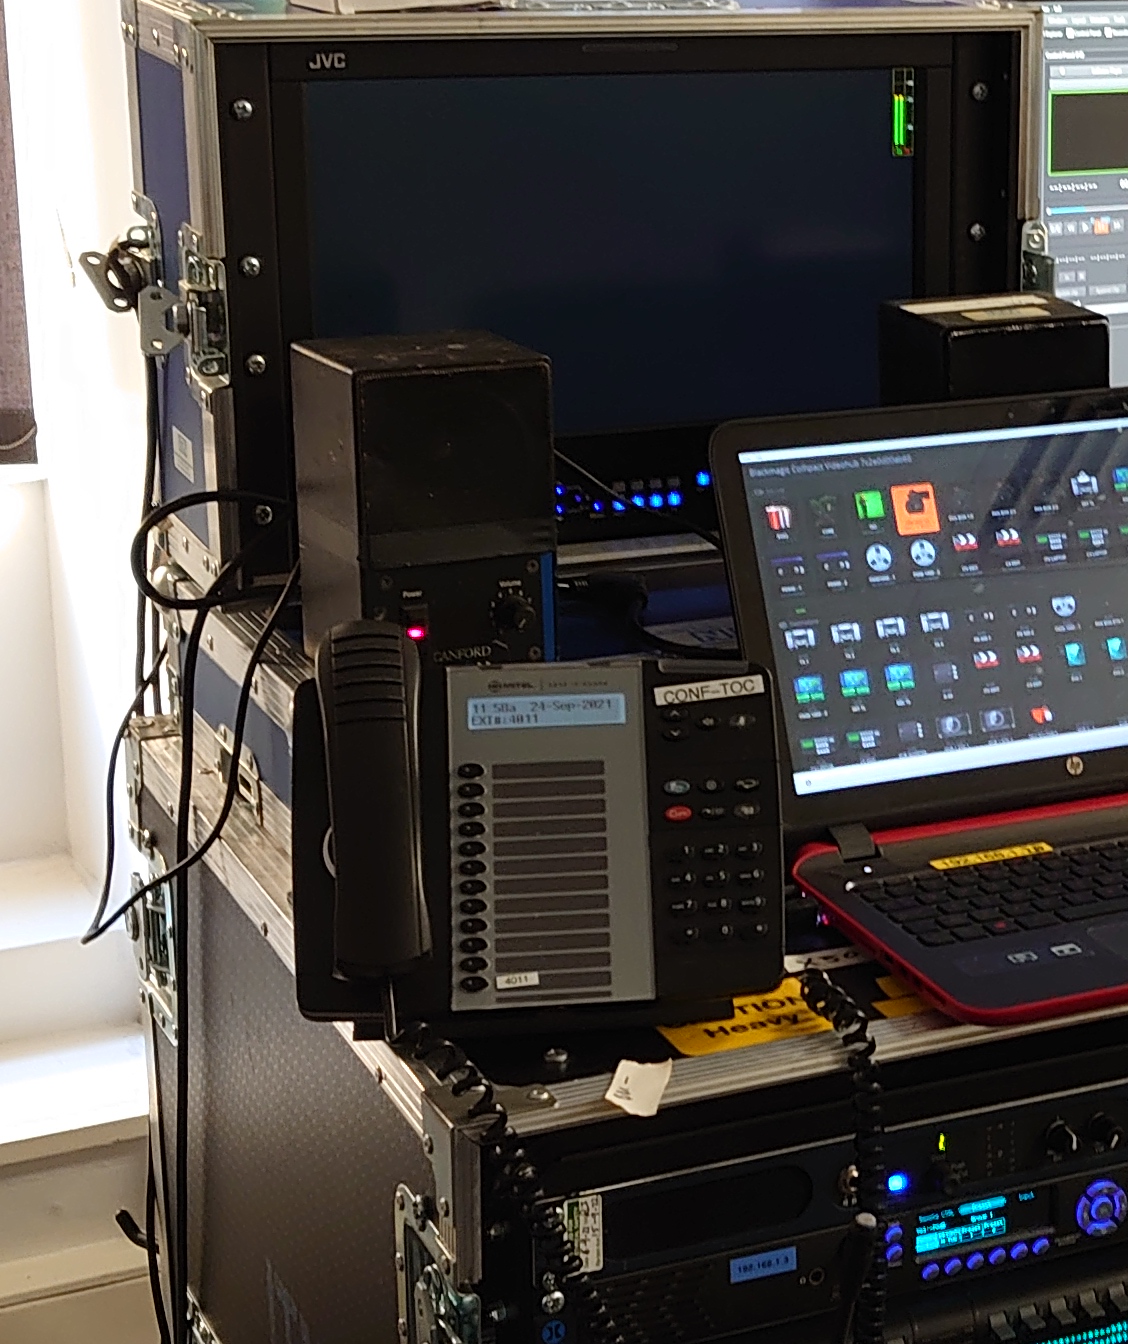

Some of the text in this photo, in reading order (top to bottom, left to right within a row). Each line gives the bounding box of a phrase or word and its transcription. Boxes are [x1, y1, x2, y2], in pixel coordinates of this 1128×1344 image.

[308, 53, 347, 71] JVC
[663, 678, 756, 705] CONF-TOC
[703, 1010, 800, 1040] Heavy
